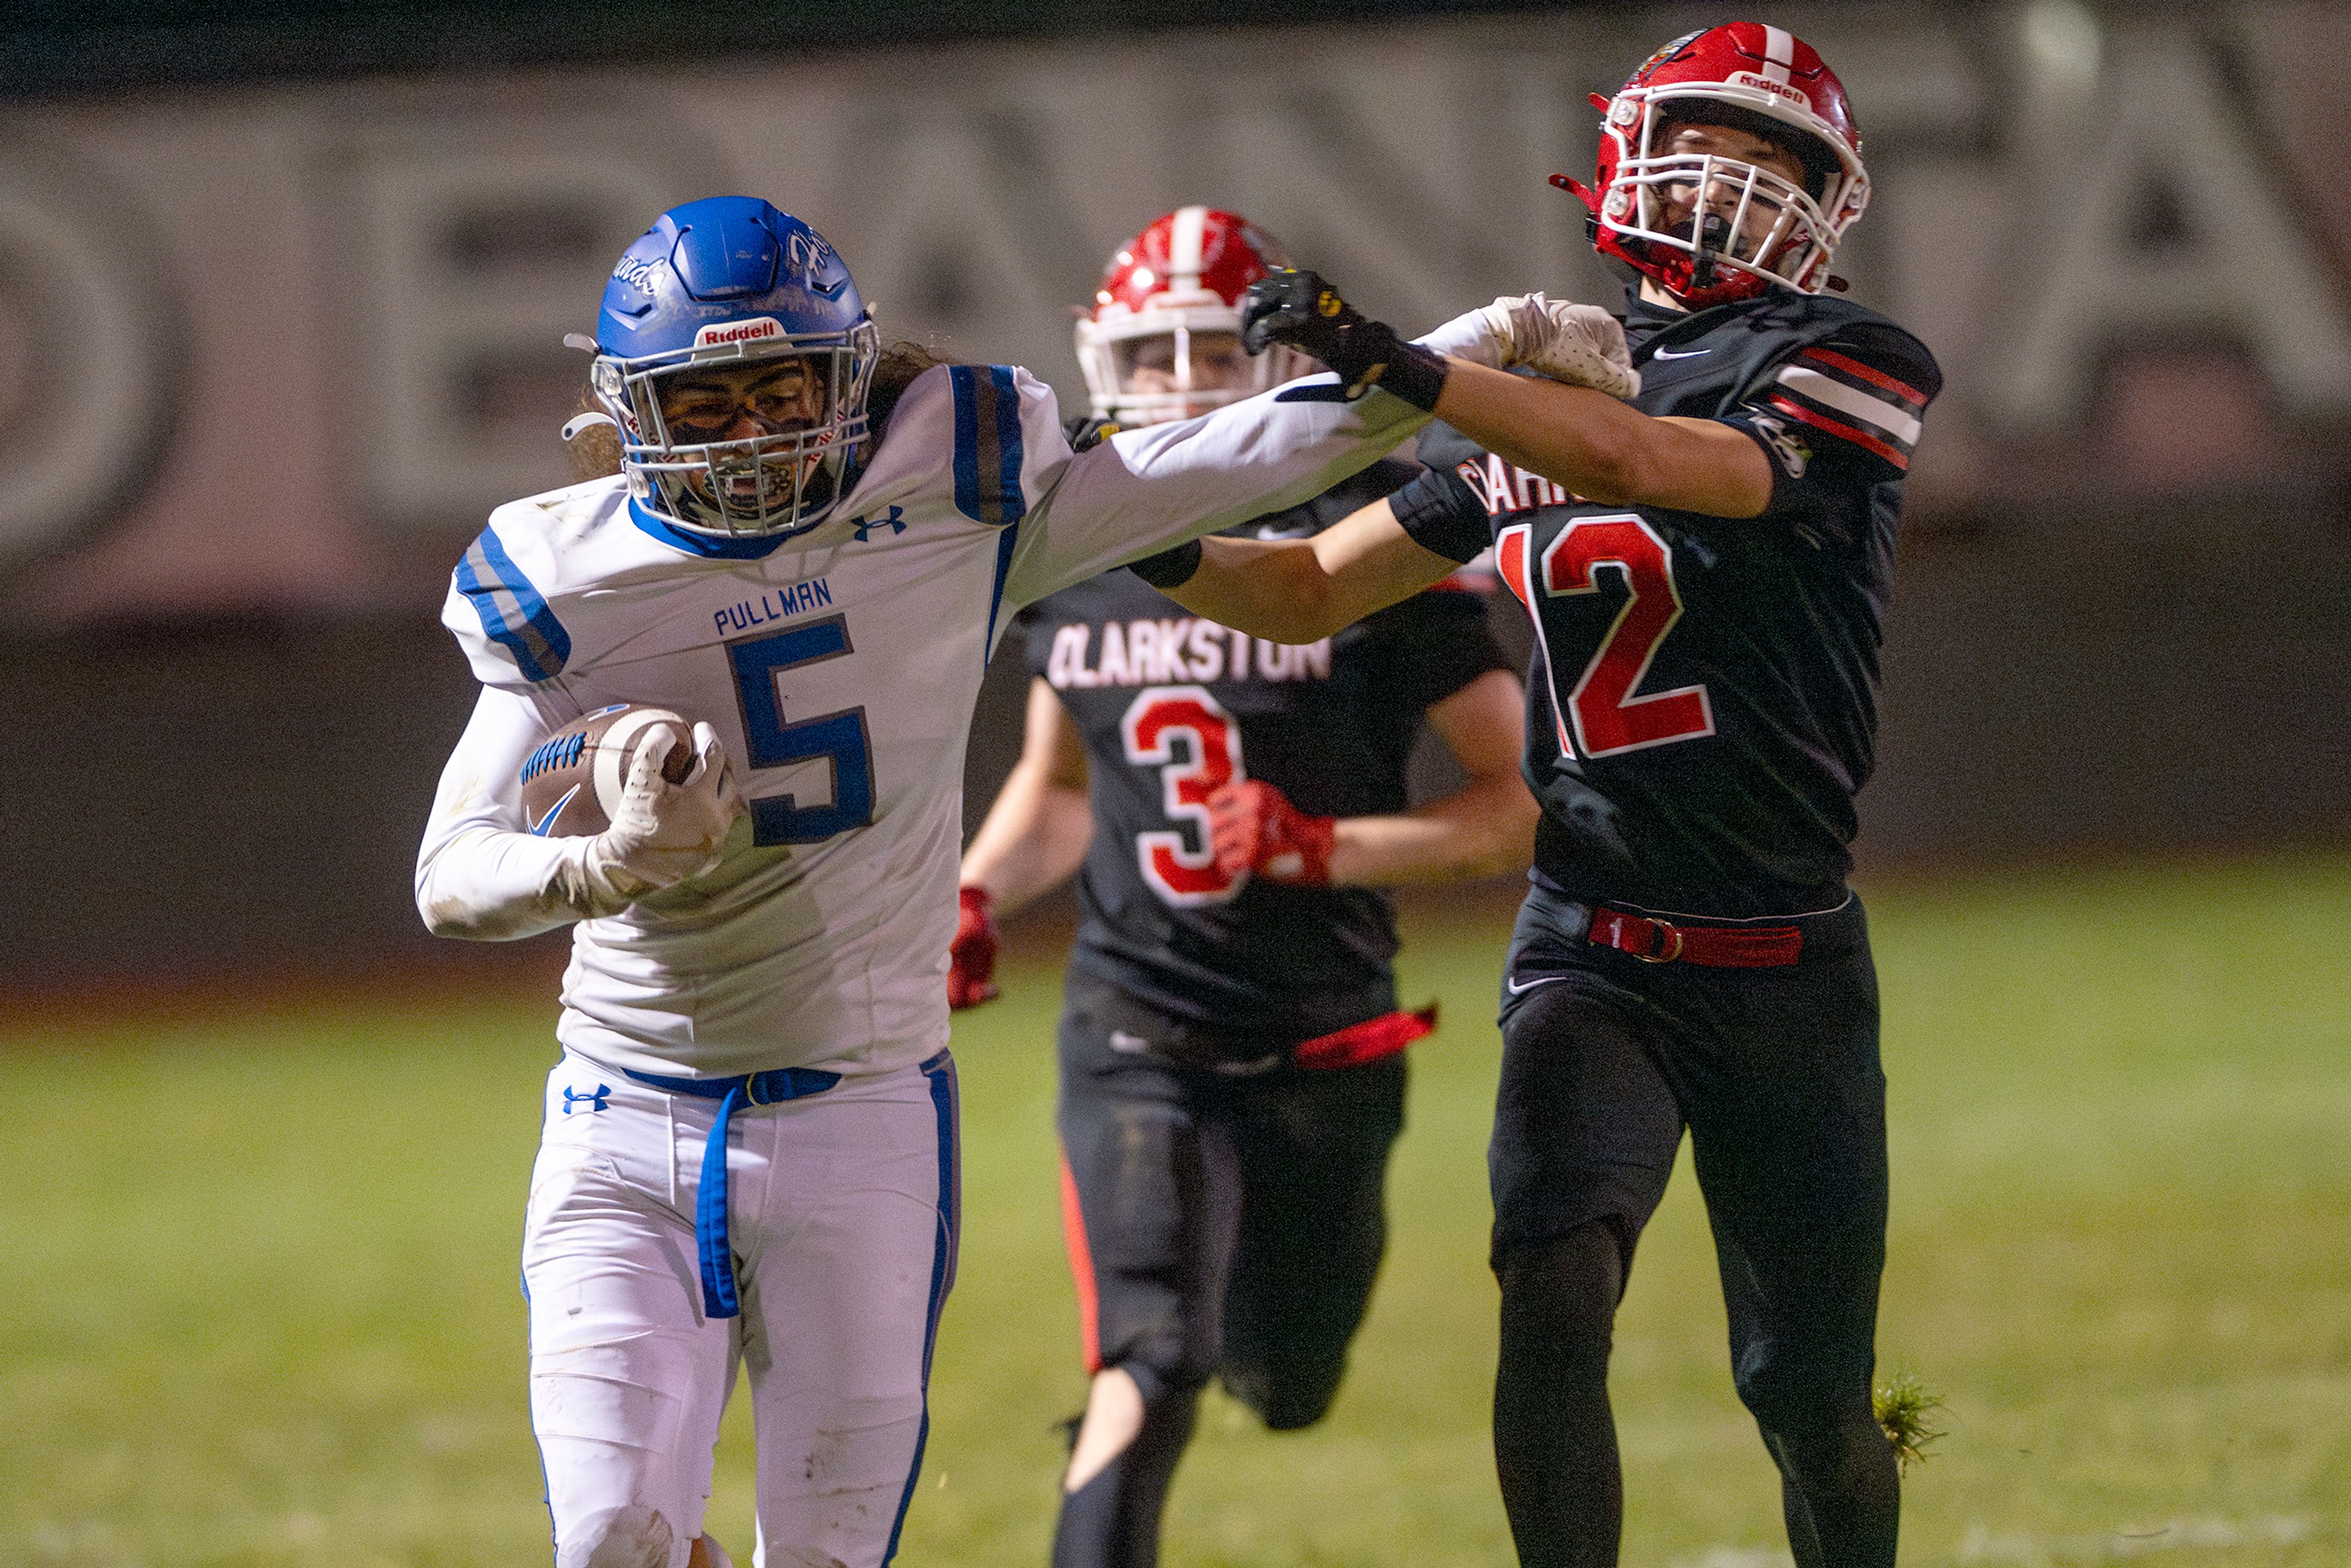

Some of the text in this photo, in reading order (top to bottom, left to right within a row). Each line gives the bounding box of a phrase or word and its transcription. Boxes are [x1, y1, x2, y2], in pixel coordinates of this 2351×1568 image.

[1740, 74, 1804, 104] Riddell
[705, 321, 774, 344] Riddell
[714, 578, 833, 636] PULLMAN
[1048, 617, 1332, 687] CLARKSTON
[724, 612, 877, 847] 5
[1121, 685, 1249, 908] 3
